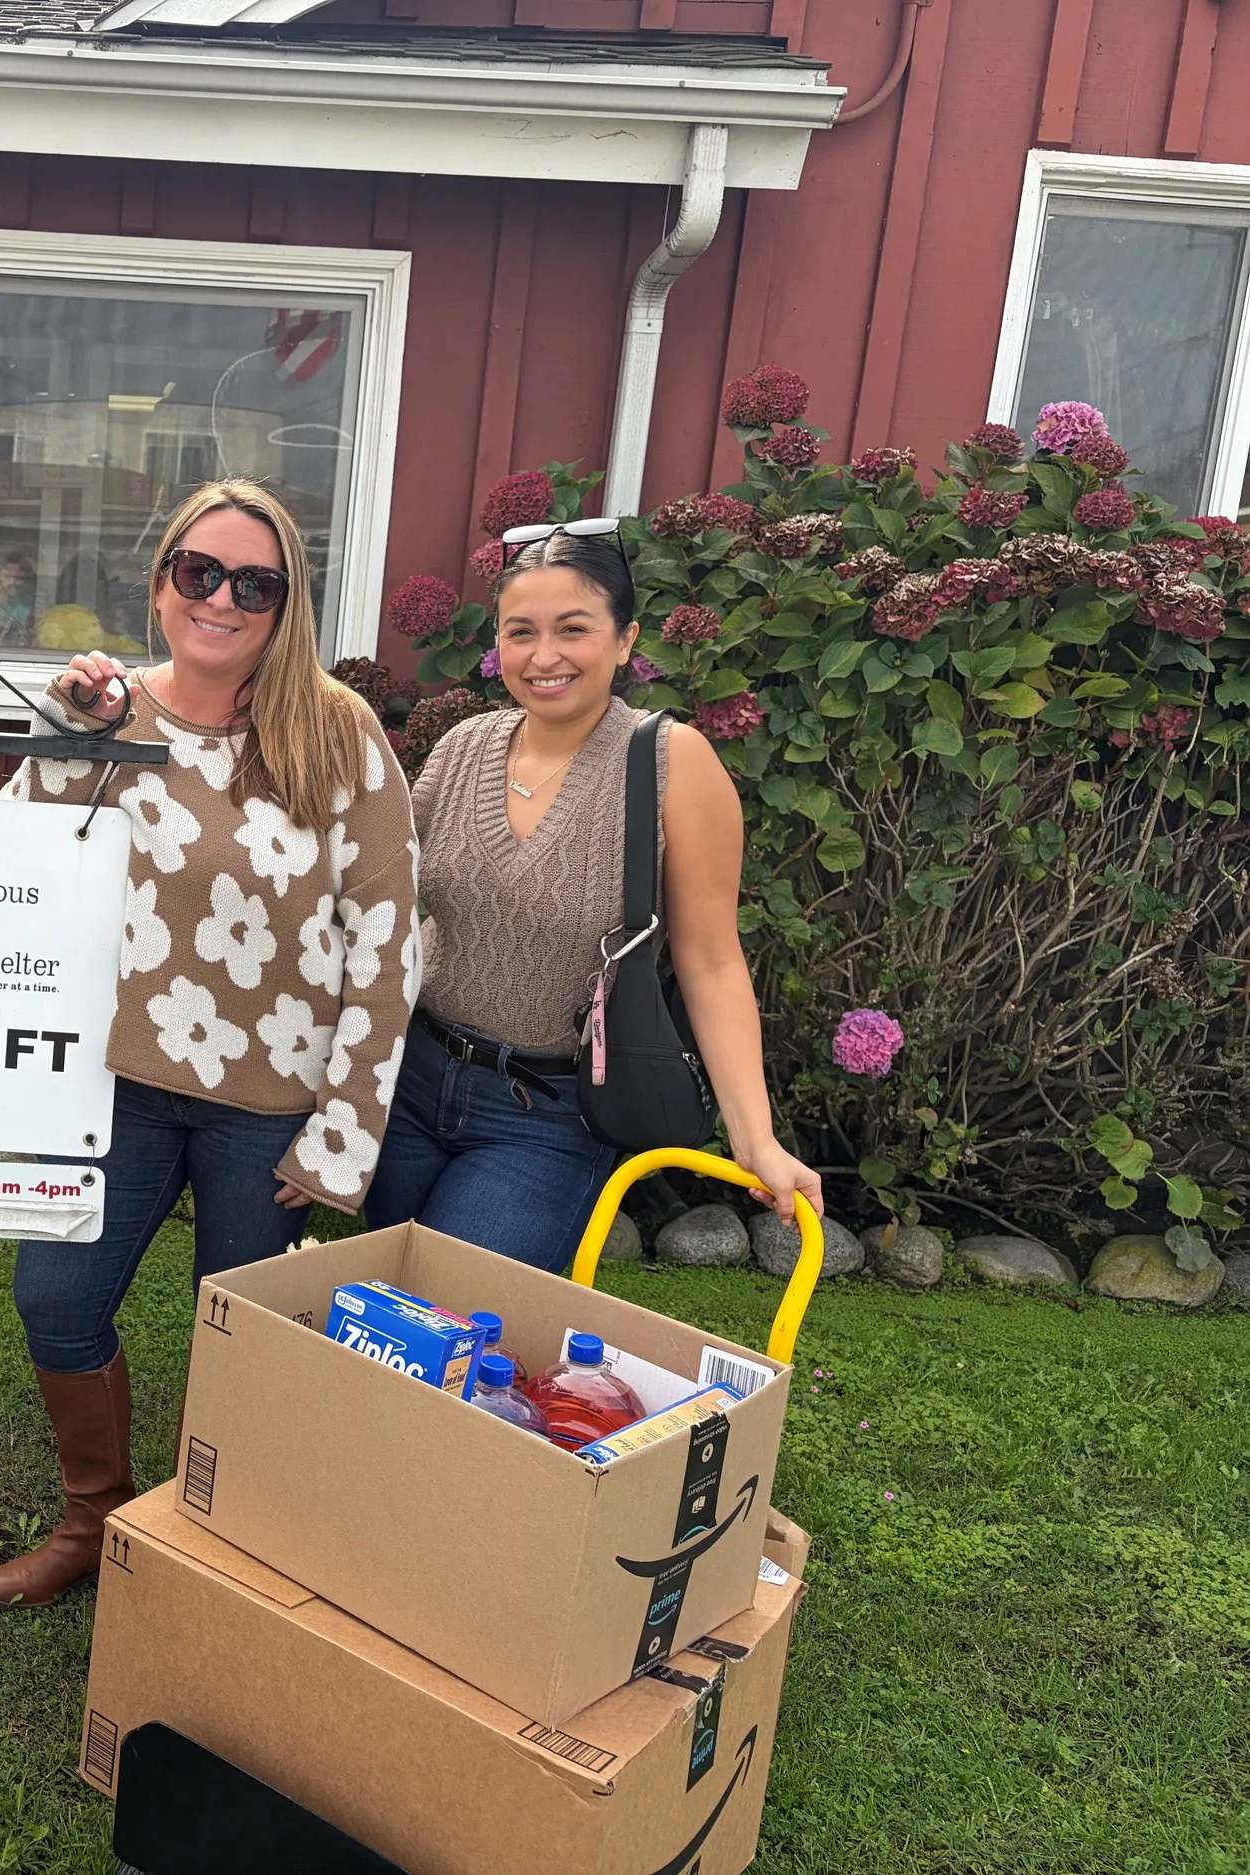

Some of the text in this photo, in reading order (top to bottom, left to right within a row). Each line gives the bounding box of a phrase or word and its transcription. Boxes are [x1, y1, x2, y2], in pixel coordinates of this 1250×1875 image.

[10, 981, 22, 991] at
[24, 983, 31, 991] a
[33, 983, 60, 993] time.
[649, 1589, 681, 1619] prime
